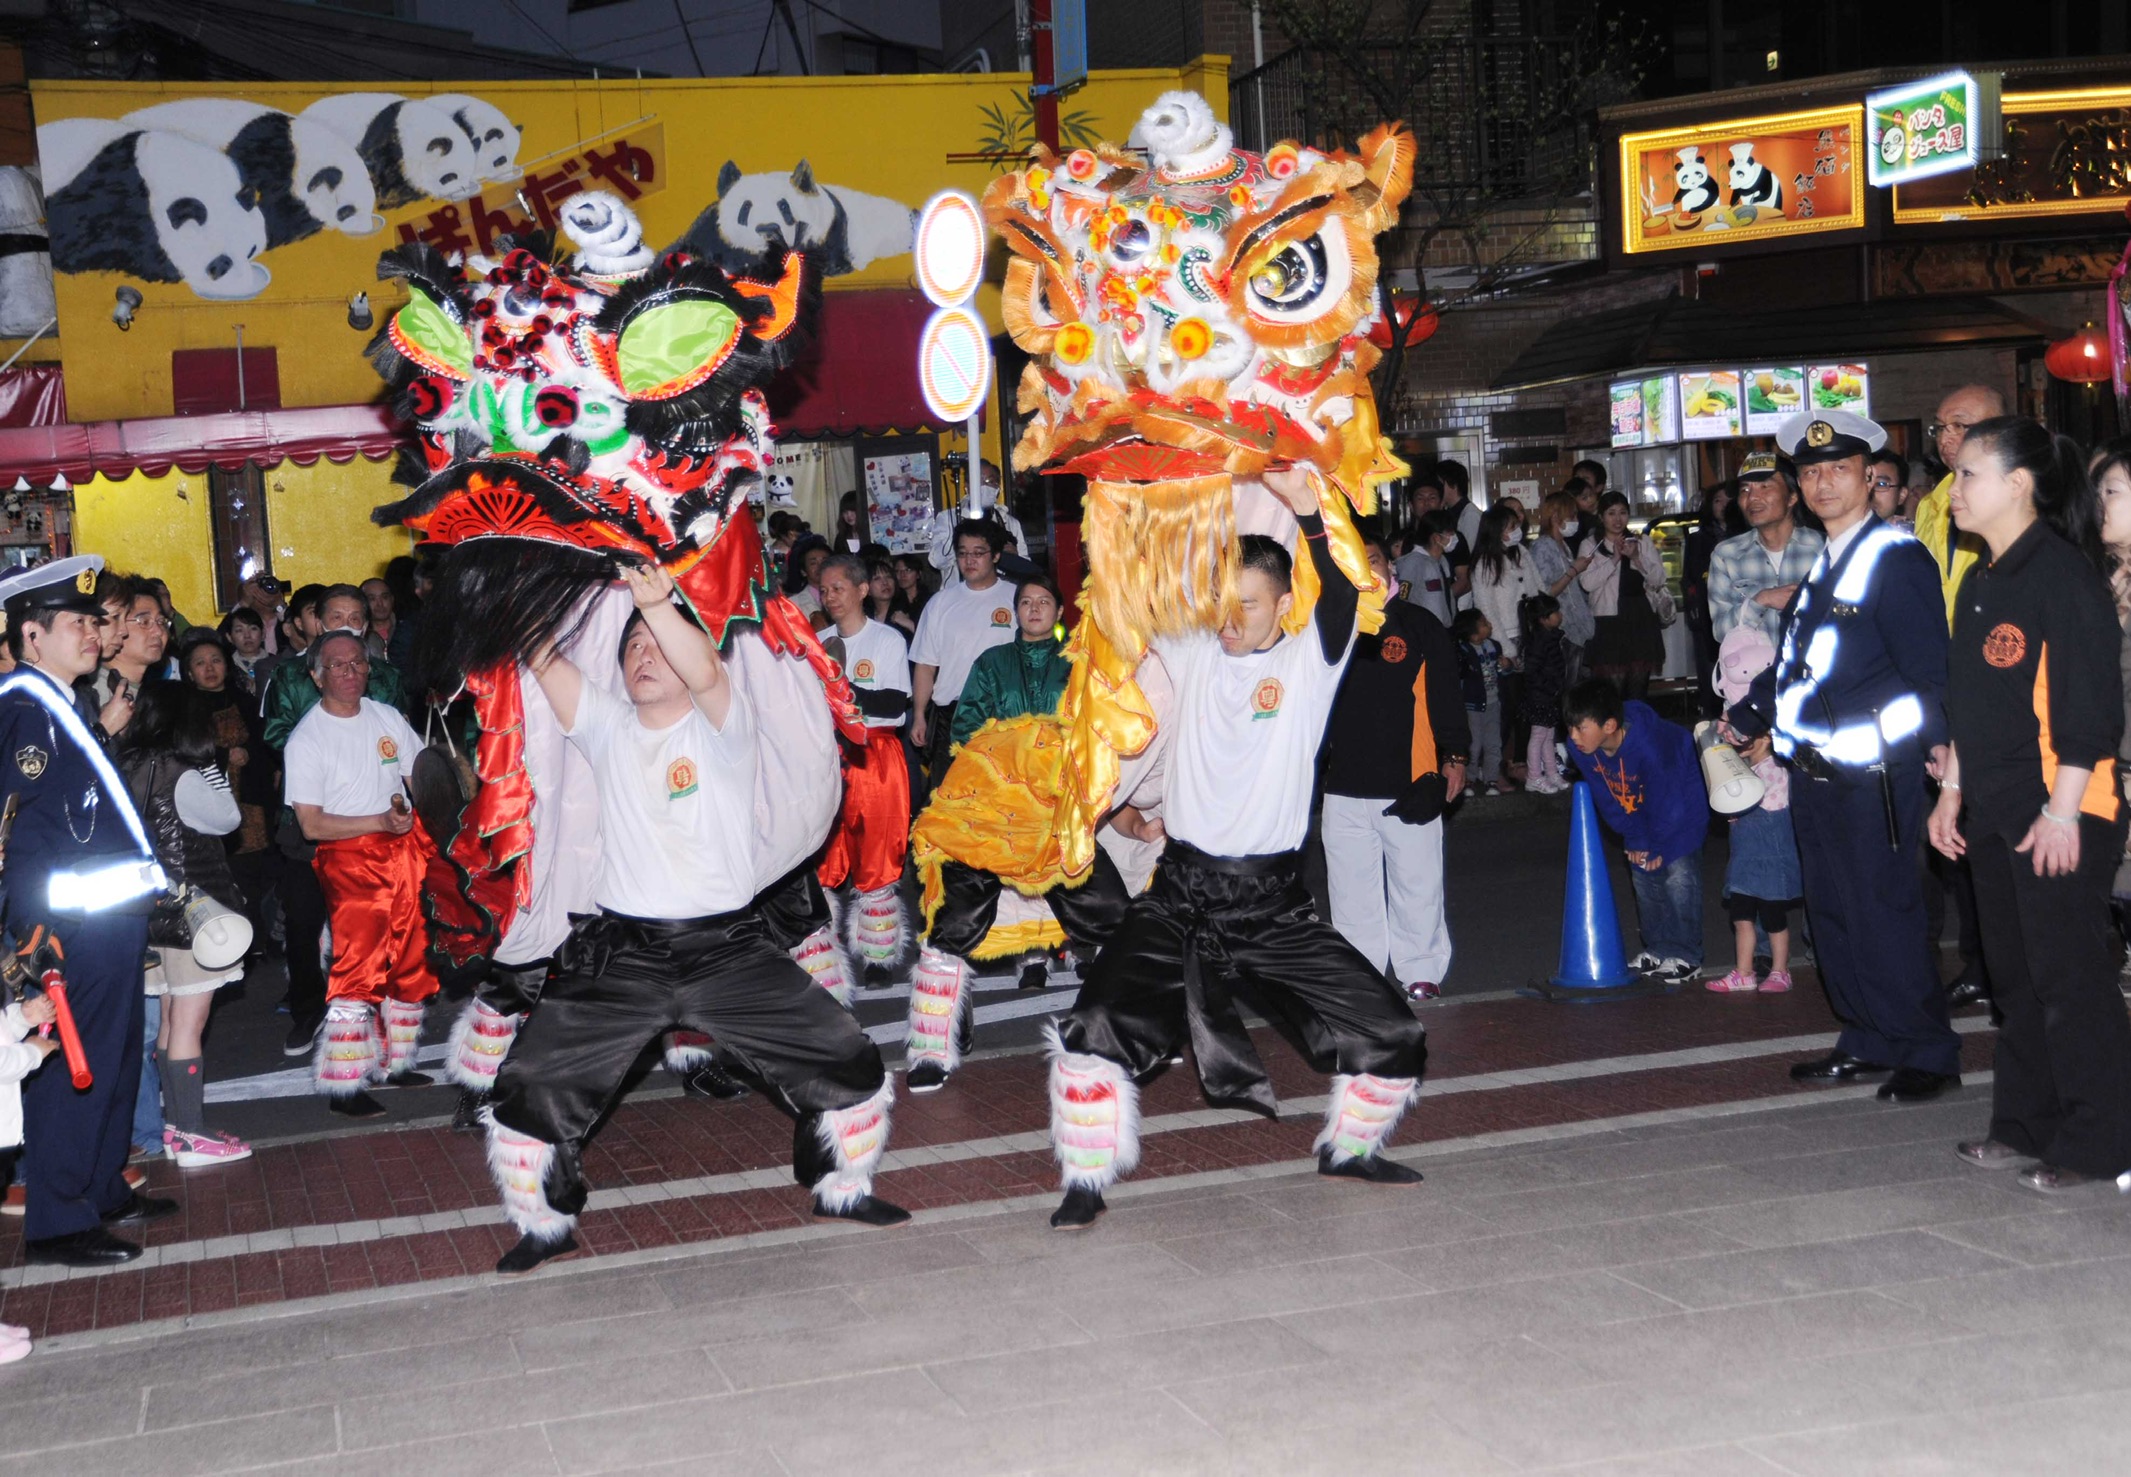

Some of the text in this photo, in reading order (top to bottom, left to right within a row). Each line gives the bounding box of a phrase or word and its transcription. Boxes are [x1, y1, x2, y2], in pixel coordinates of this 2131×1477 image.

[1908, 123, 1964, 160] ジュース屋
[397, 140, 655, 258] ぱんだや
